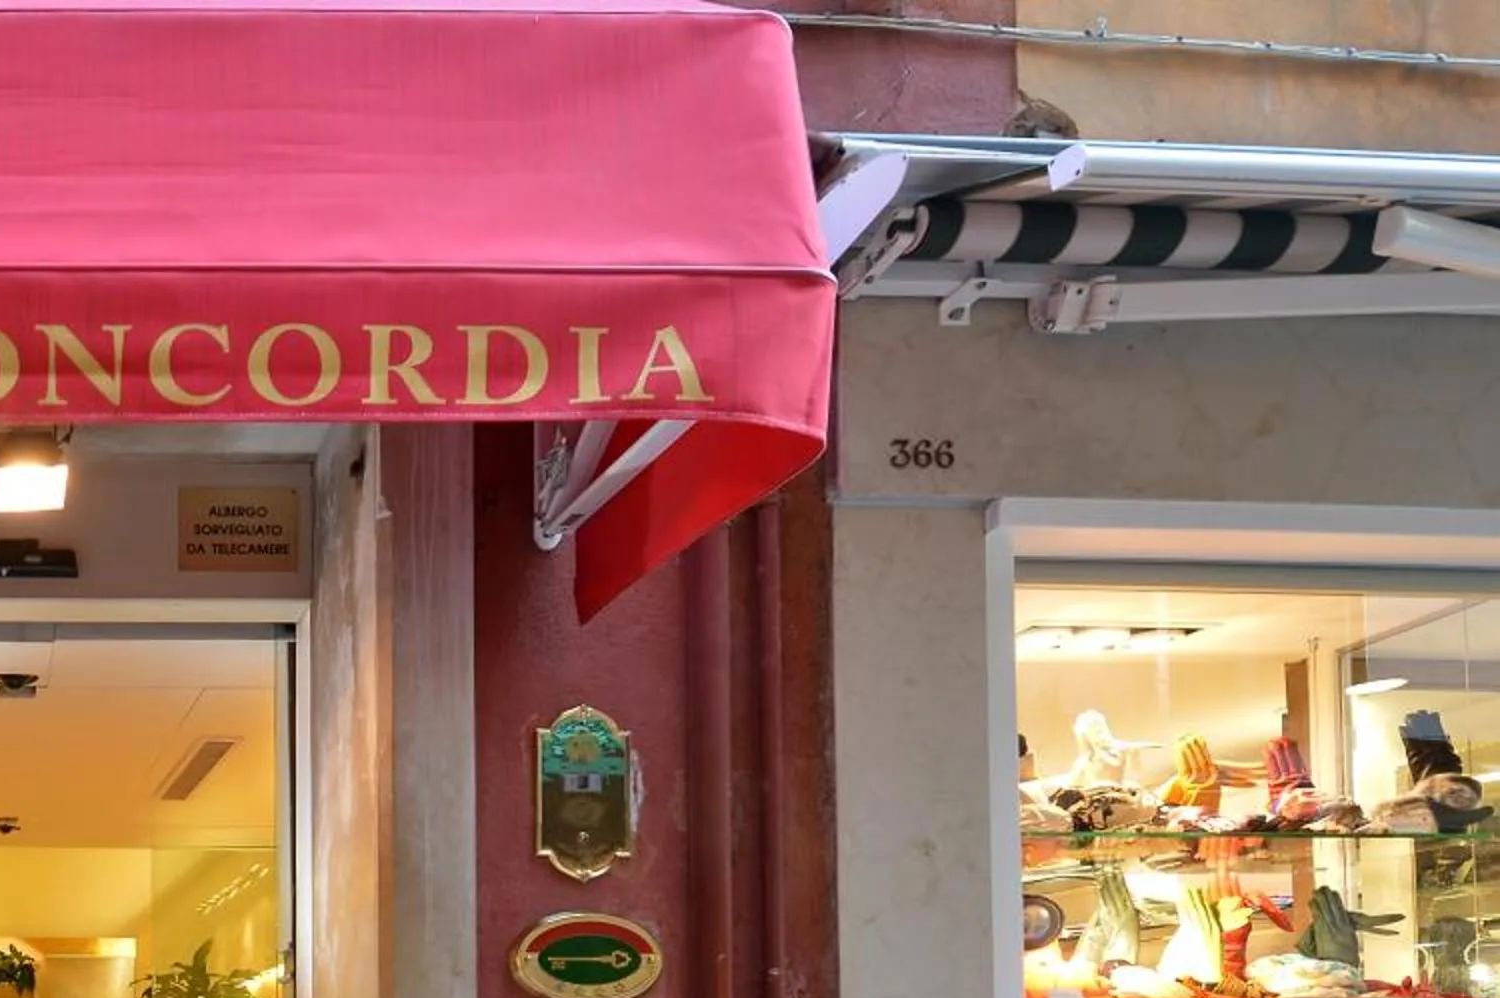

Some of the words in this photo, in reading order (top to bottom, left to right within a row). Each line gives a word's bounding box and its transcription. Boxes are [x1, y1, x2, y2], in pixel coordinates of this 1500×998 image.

[889, 438, 954, 469] 366
[209, 505, 269, 518] ALBERGO
[186, 543, 206, 555] DA
[212, 543, 291, 555] TELECAMERE
